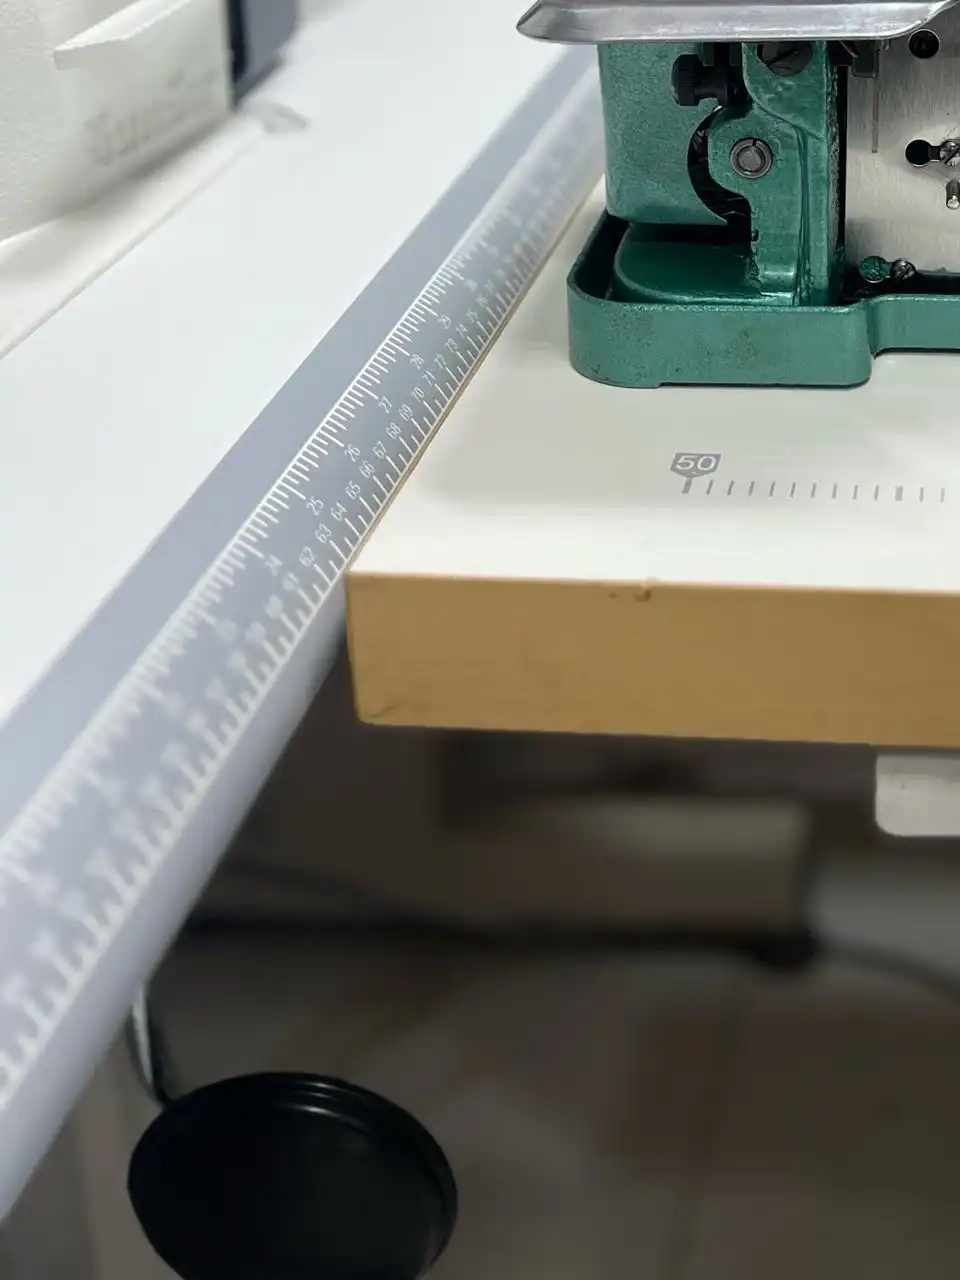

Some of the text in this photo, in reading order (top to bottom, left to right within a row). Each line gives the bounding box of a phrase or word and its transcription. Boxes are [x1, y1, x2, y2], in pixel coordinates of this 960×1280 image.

[299, 546, 315, 567] 62
[314, 523, 332, 544] 63
[330, 501, 347, 521] 64
[345, 480, 361, 500] 65
[359, 459, 375, 478] 66
[372, 440, 387, 459] 67
[386, 422, 401, 440] 68
[399, 404, 413, 421] 69
[410, 386, 425, 403] 70
[422, 370, 436, 386] 71
[434, 353, 447, 369] 72
[445, 338, 458, 352] 73
[456, 323, 468, 338] 74
[306, 496, 324, 516] 25
[344, 443, 361, 462] 26
[378, 396, 393, 414] 27
[410, 353, 424, 370] 28
[675, 455, 717, 471] 50
